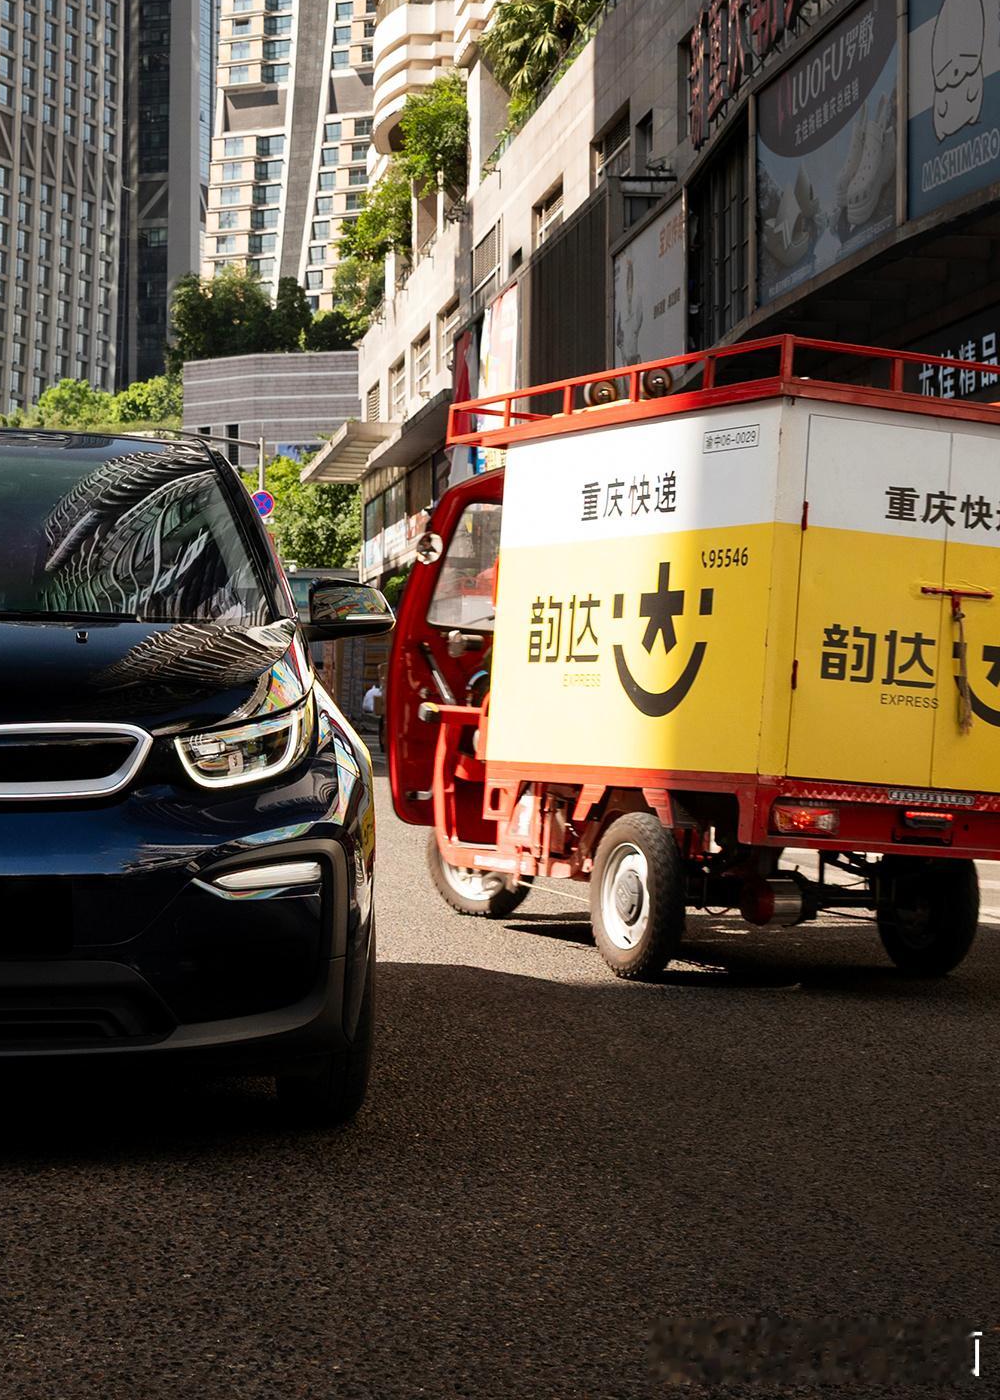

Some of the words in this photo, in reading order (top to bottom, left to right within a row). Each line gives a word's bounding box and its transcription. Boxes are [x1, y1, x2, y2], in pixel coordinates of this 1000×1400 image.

[792, 36, 844, 116] LUOFU
[921, 127, 1000, 192] MASHIMARO
[581, 470, 677, 522] 重庆快递
[884, 485, 1000, 532] 重庆快
[708, 546, 749, 569] 95546
[527, 592, 601, 663] 韵达
[562, 672, 601, 688] EXPRESS
[820, 623, 936, 689] 韵达
[880, 692, 939, 710] EXPRESS
